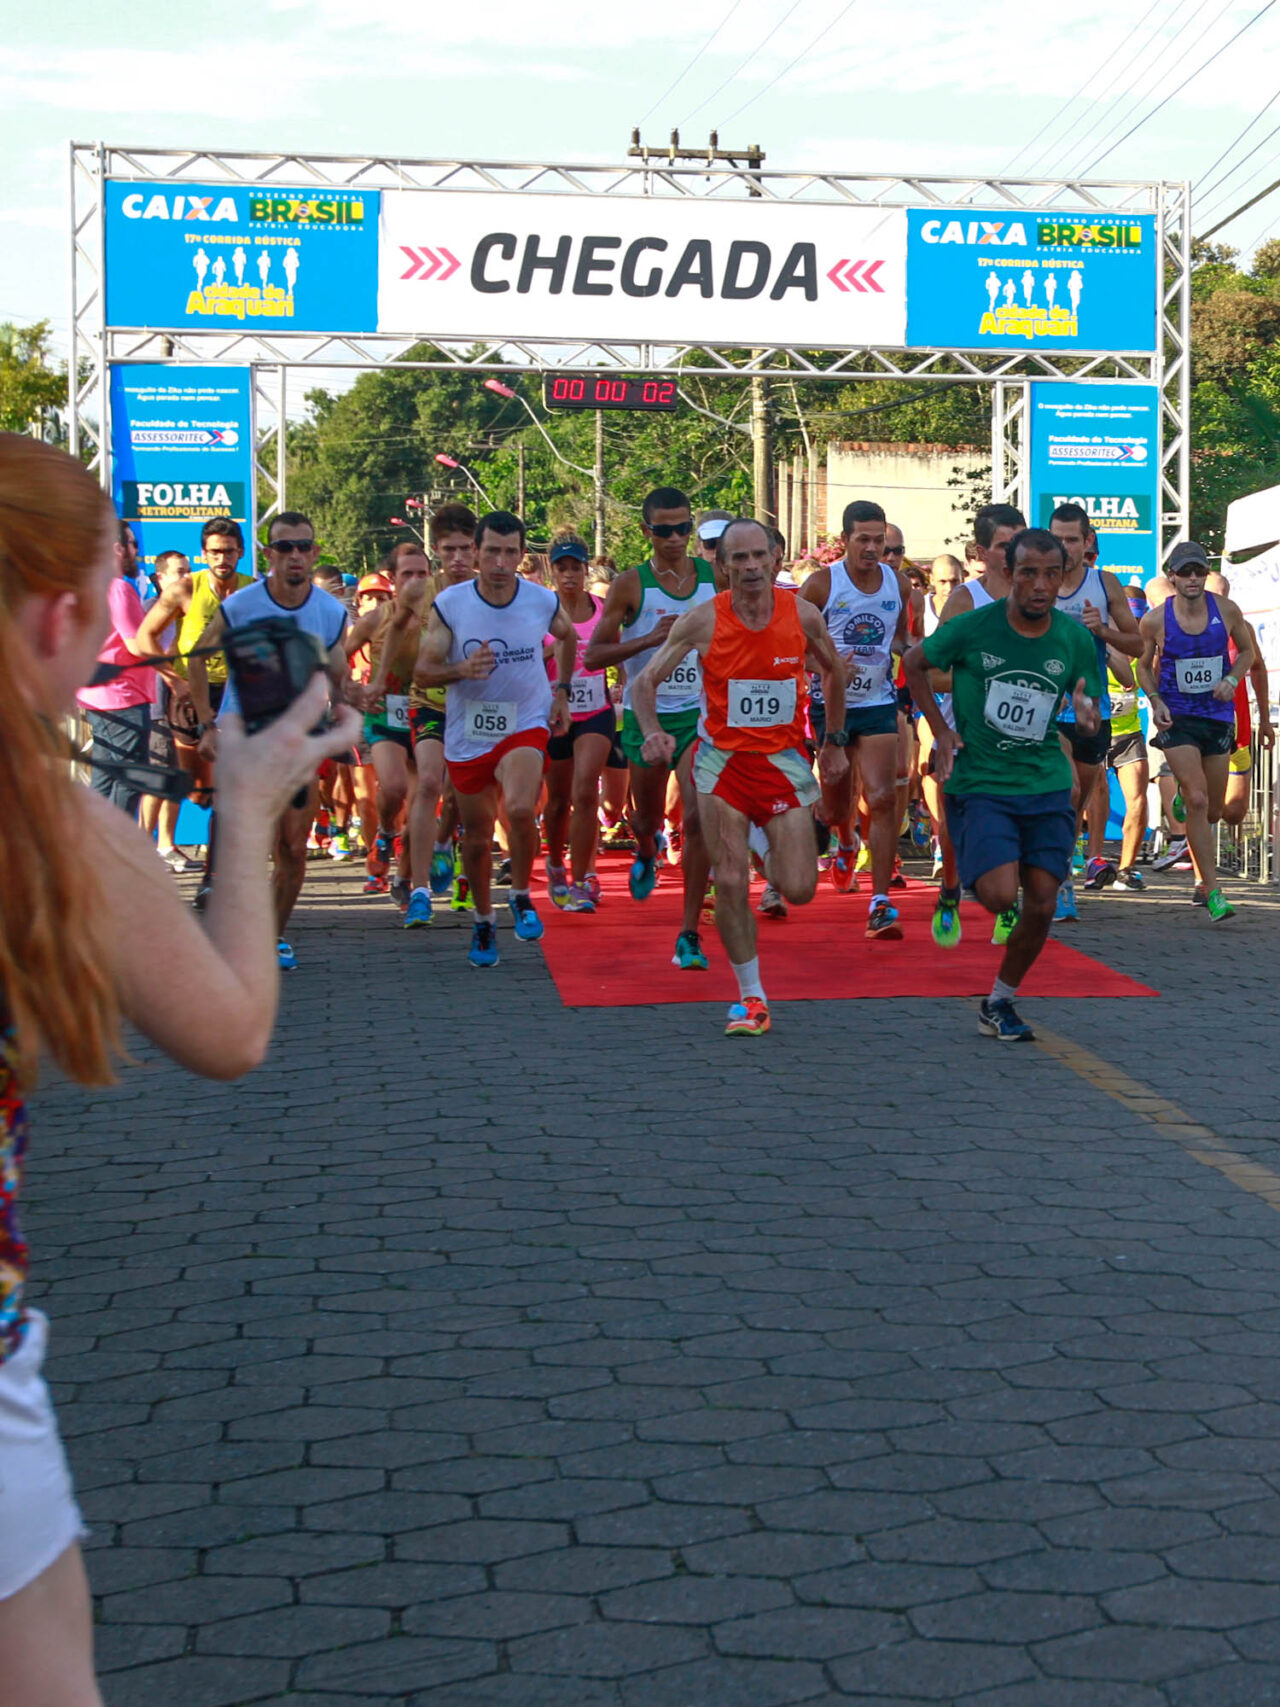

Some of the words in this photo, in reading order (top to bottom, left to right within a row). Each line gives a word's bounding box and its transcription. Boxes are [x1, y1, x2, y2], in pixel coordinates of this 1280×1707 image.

[121, 193, 239, 222] CAIXA
[250, 199, 364, 224] BRASIL
[203, 234, 251, 245] CORRIDA
[254, 233, 302, 247] RÚSTICA
[920, 220, 1028, 246] CAIXA
[1037, 224, 1142, 248] BRASIL
[470, 232, 819, 302] CHEGADA
[994, 258, 1040, 268] CORRIDA
[1041, 257, 1086, 269] RÚSTICA
[204, 282, 261, 299] cidade
[263, 283, 286, 299] de
[186, 290, 295, 319] Araquari
[996, 303, 1047, 320] cidade
[1049, 304, 1071, 320] de
[978, 311, 1079, 339] Araquari
[553, 379, 585, 400] 00
[595, 380, 628, 402] 00
[642, 382, 675, 403] 02
[134, 432, 206, 442] ASSESSORITEC
[1052, 447, 1117, 457] ASSESSORITEC
[136, 483, 233, 506] FOLHA
[137, 506, 232, 517] METROPOLITANA
[1088, 518, 1139, 528] POLITANA
[846, 676, 873, 692] 94
[1184, 670, 1212, 684] 048
[740, 697, 780, 715] 019
[997, 701, 1036, 726] 001
[474, 713, 508, 732] 058
